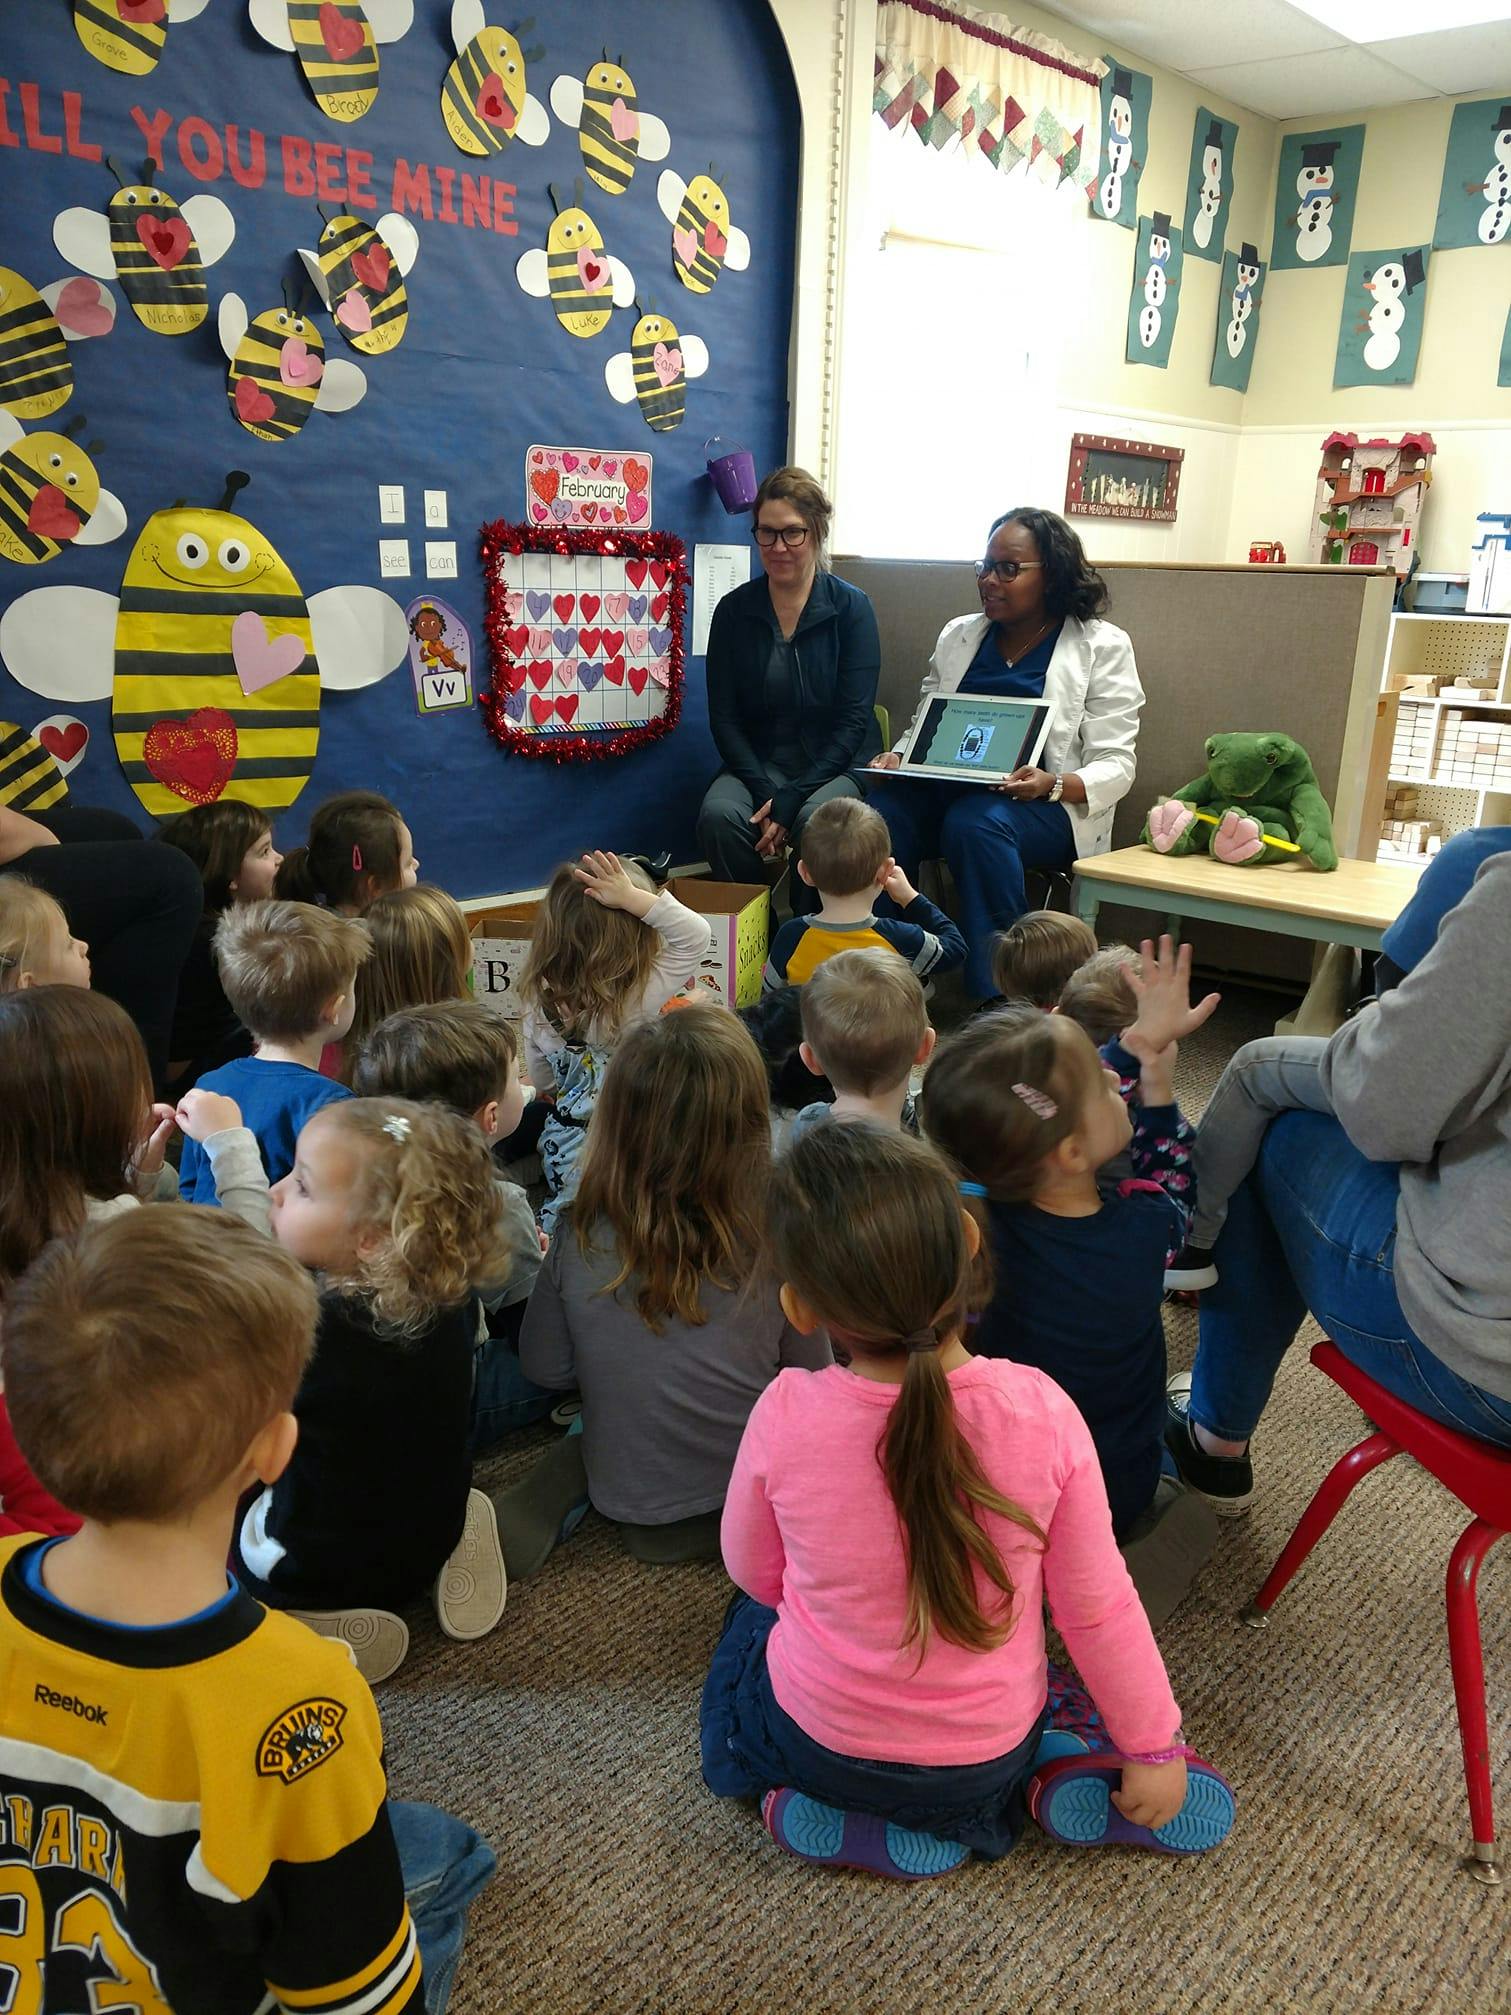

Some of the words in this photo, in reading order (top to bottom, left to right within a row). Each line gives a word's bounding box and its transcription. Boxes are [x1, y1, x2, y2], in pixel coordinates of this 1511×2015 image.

[129, 104, 266, 189] YOU
[280, 135, 378, 209] BEE
[391, 157, 520, 237] MINE
[561, 476, 626, 506] February
[386, 493, 399, 513] I
[429, 505, 439, 518] a
[1077, 503, 1088, 514] THE
[1088, 504, 1111, 516] MEADOW
[1111, 506, 1120, 516] WE
[1120, 506, 1130, 517] CAN
[1130, 507, 1145, 518] BUILD
[1145, 509, 1150, 519] A
[1151, 509, 1177, 520] SNOWMAN
[383, 555, 407, 568] see
[429, 556, 455, 570] can
[432, 678, 456, 698] Vv
[484, 960, 511, 993] B
[34, 1683, 109, 1727] Reebok
[263, 1704, 340, 1768] BRUINS
